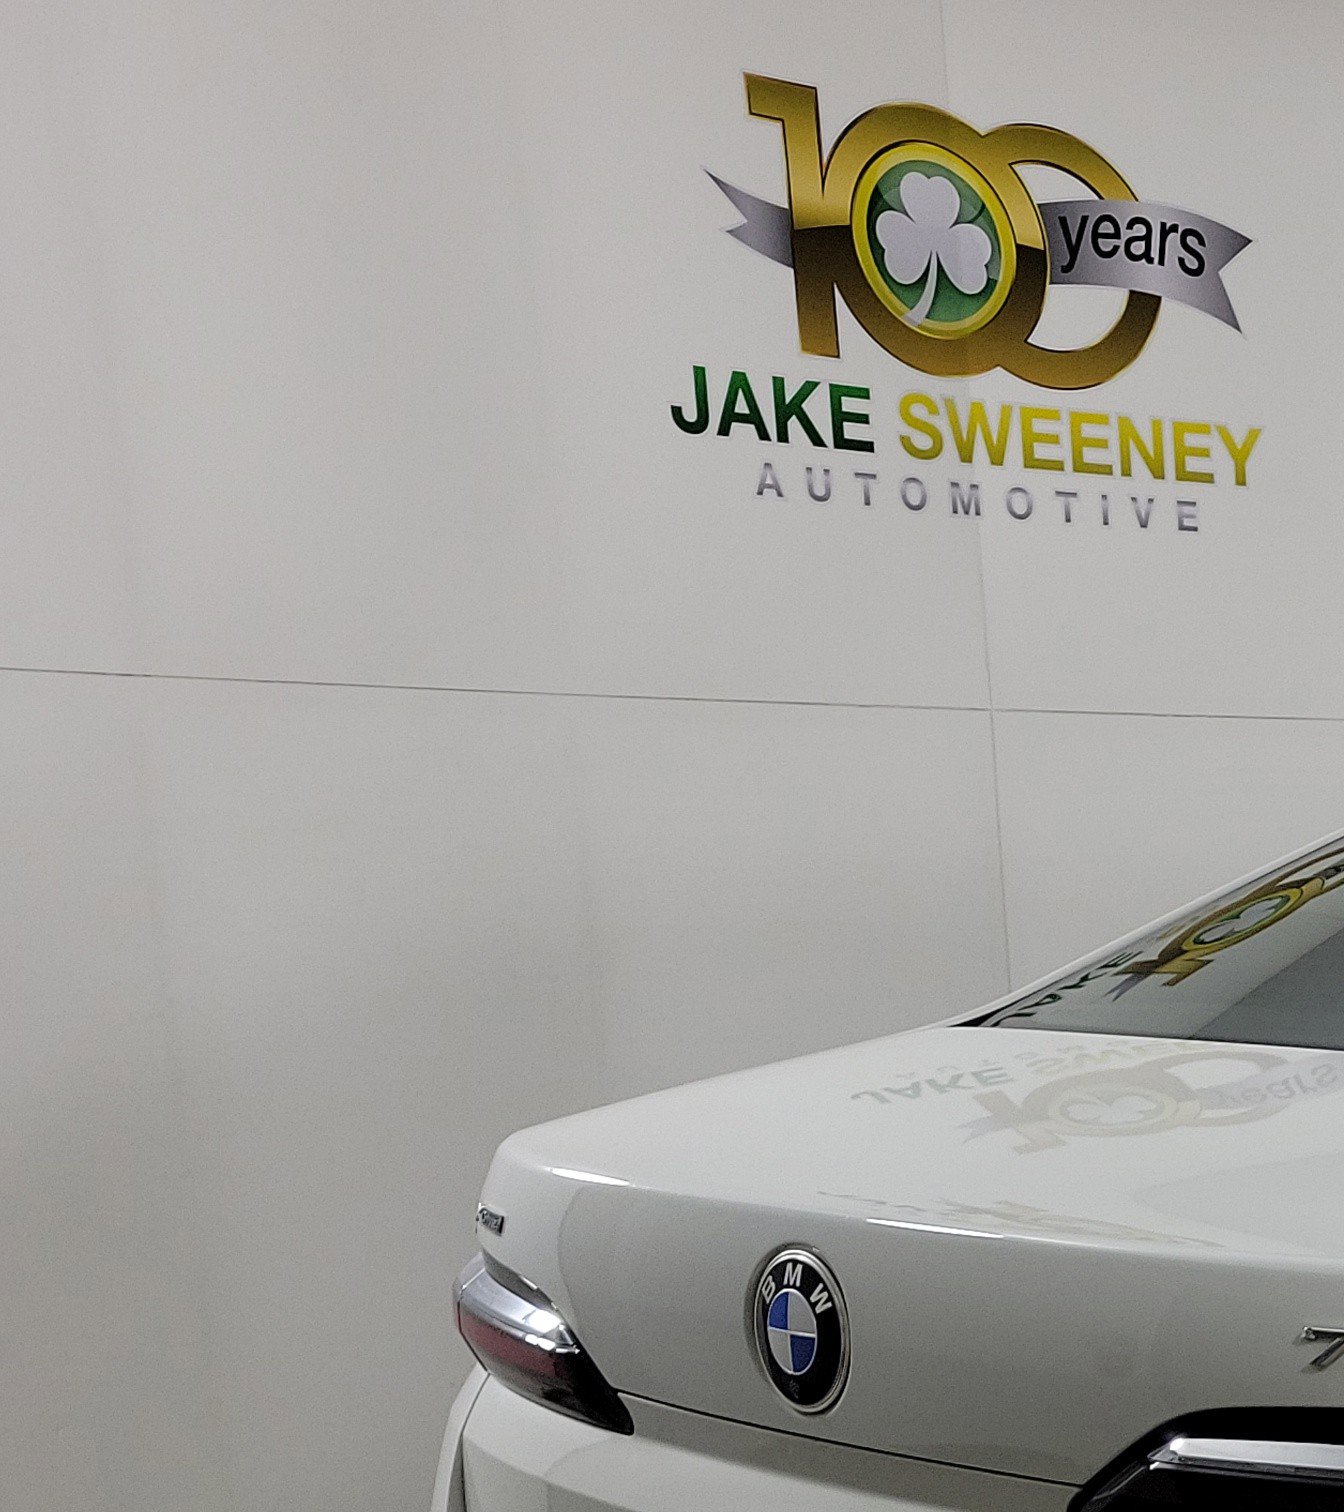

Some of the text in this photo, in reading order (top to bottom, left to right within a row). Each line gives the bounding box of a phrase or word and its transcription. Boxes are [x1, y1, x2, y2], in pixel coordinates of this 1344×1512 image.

[743, 71, 1163, 391] 100
[1056, 211, 1207, 278] years
[670, 365, 1263, 488] JAKE SWEENEY
[756, 462, 1200, 533] AUTOMOTIVE
[761, 1262, 833, 1314] BMW
